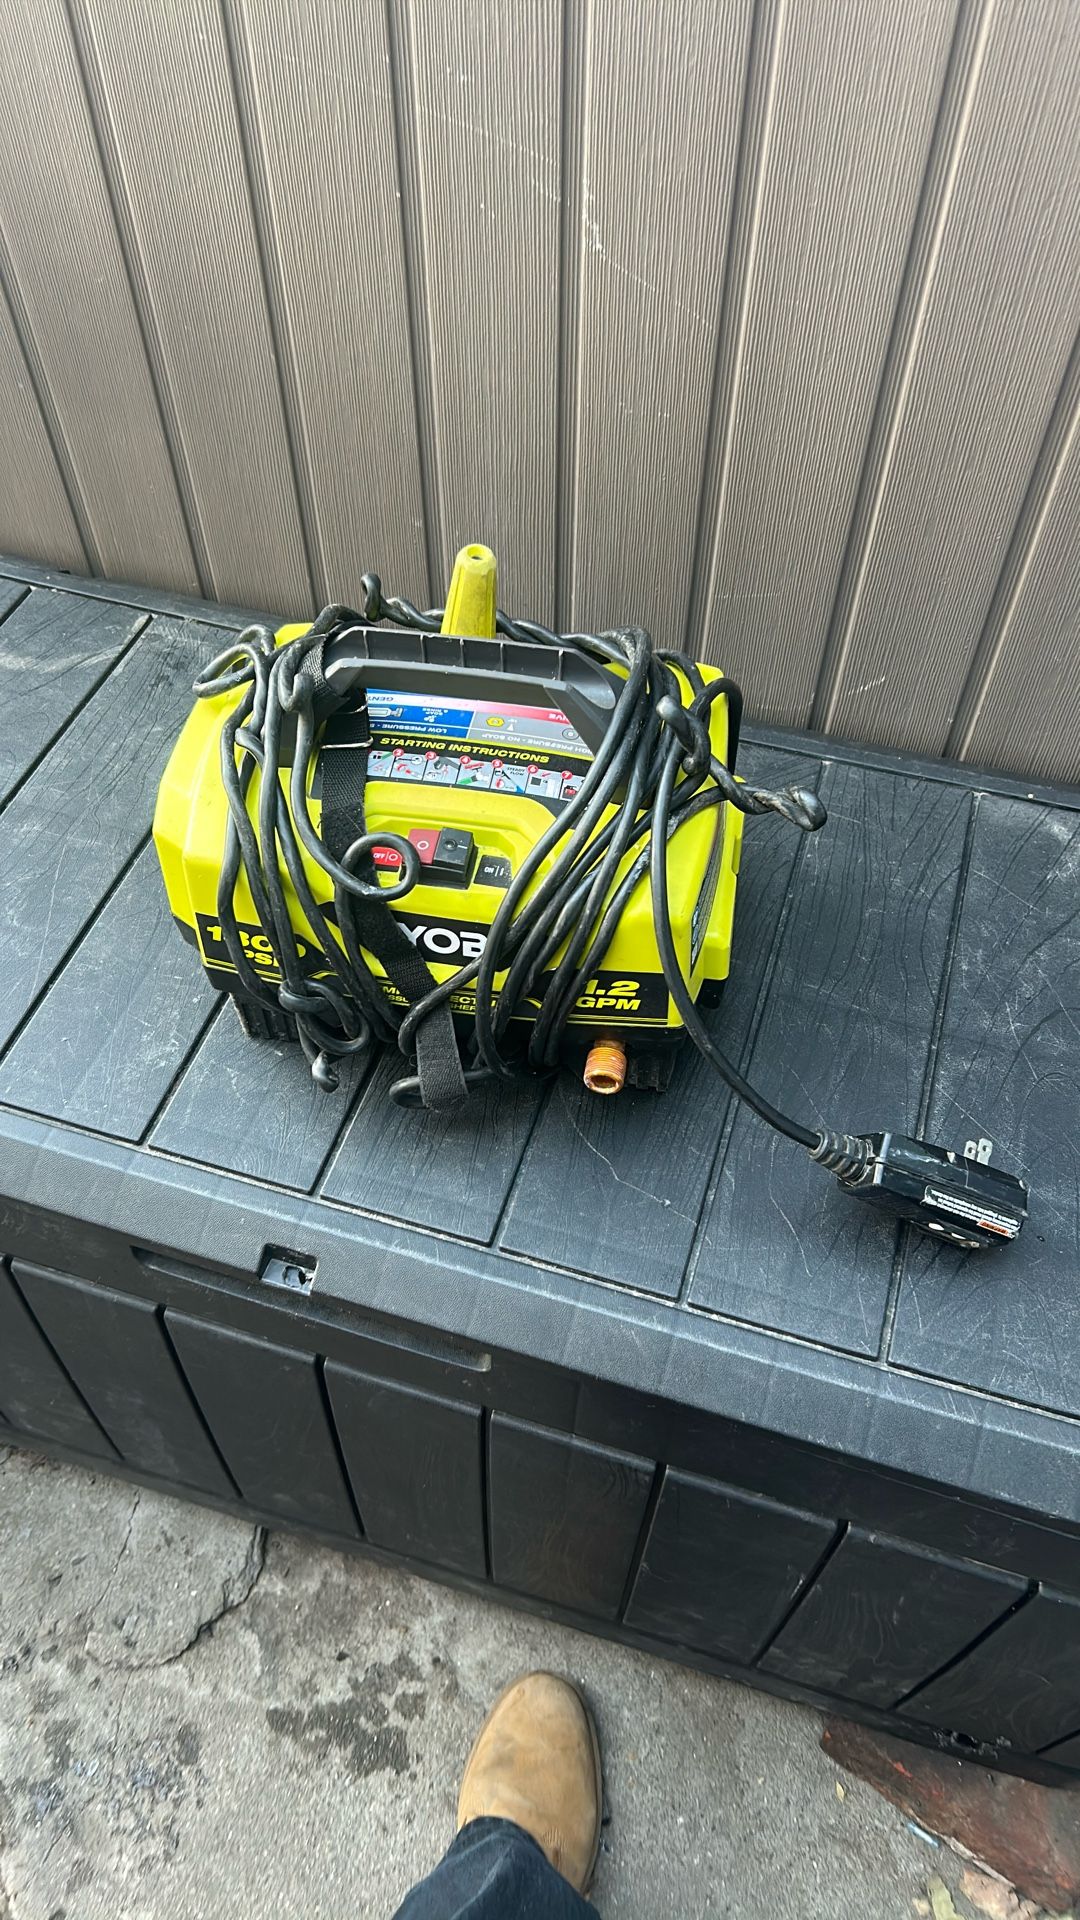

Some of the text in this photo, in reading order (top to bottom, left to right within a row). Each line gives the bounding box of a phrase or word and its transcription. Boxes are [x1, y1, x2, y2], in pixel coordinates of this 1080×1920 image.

[382, 723, 427, 732] PRESSURE
[427, 726, 447, 734] LOW
[379, 737, 550, 764] STARTING INSTRUCTIONS
[527, 739, 573, 751] PRESSURE
[397, 922, 488, 958] YOB
[585, 979, 640, 997] 1.2
[575, 996, 641, 1011] GPM
